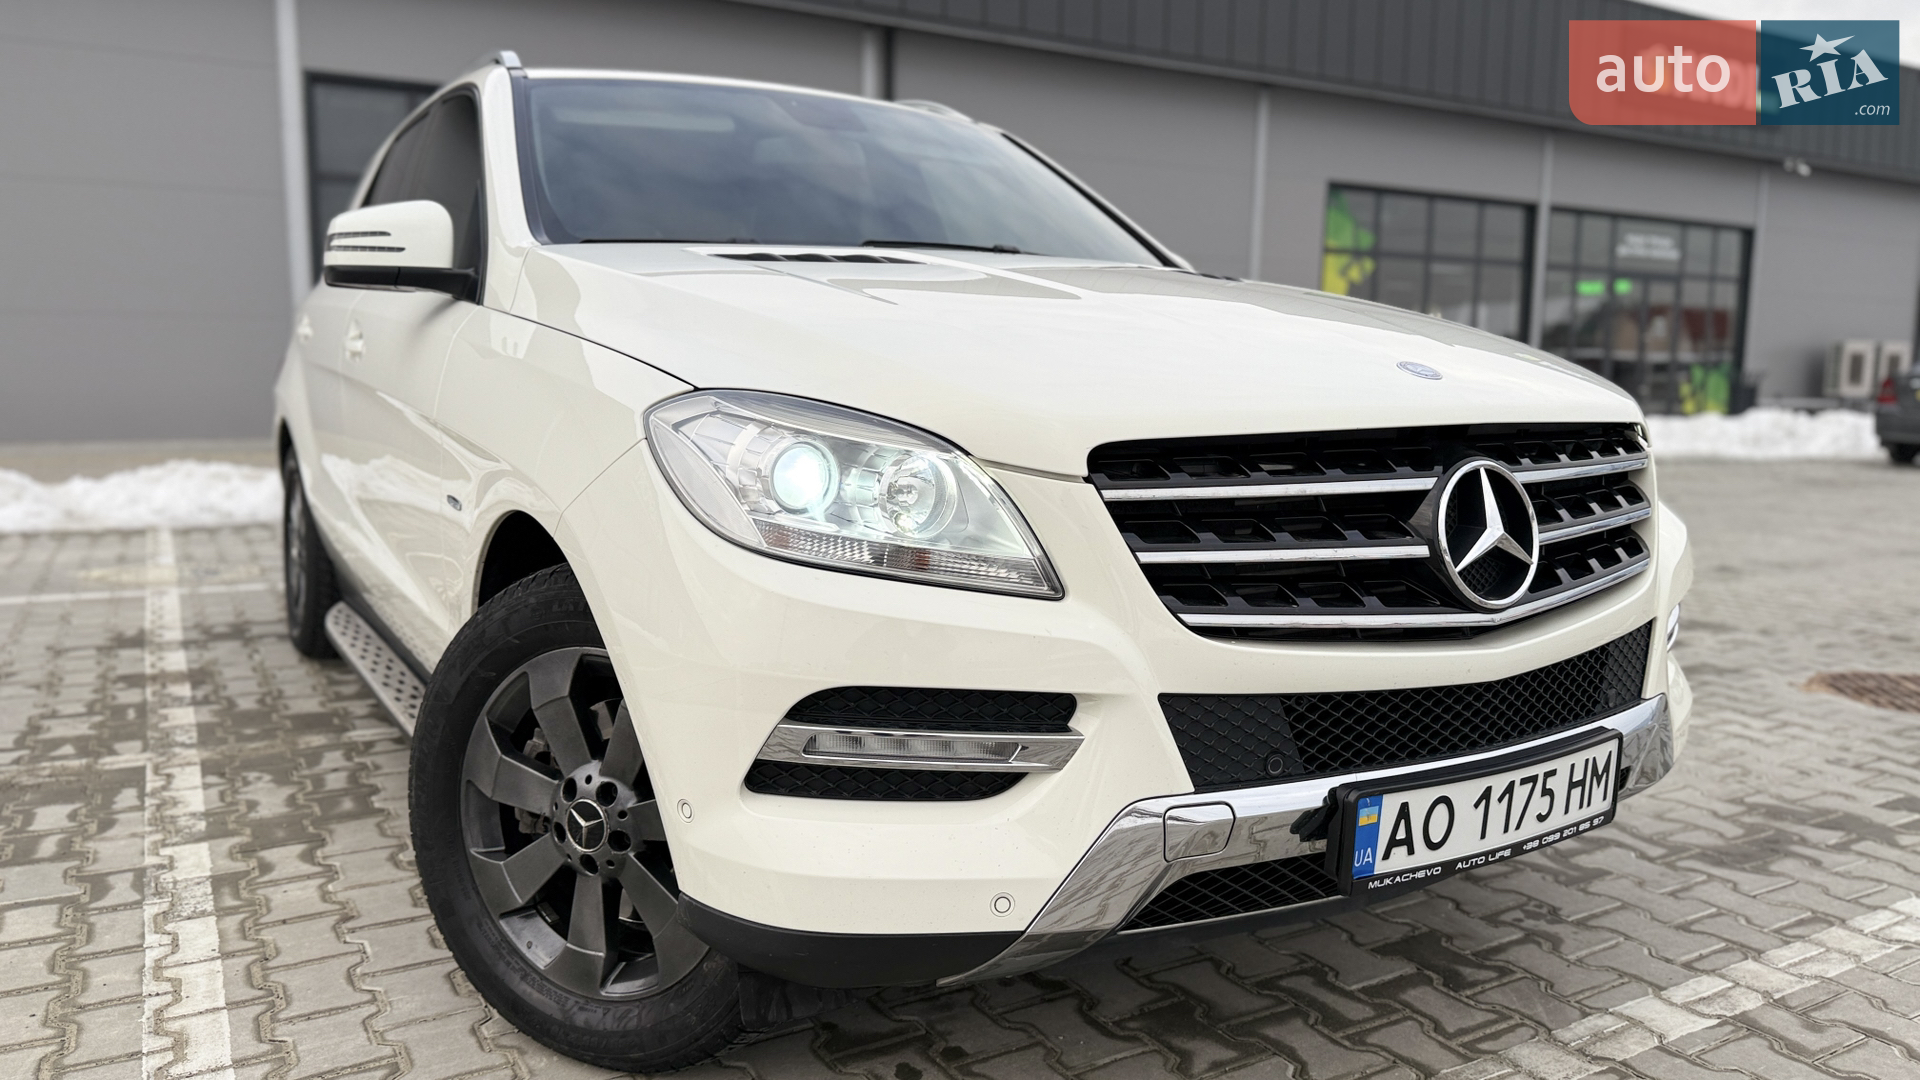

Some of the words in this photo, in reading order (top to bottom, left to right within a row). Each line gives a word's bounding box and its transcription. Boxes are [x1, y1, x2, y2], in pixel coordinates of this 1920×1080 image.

[1382, 795, 1455, 861] AO
[1473, 769, 1558, 840] 1175
[1564, 750, 1613, 815] HM
[1354, 847, 1373, 868] UA
[1368, 866, 1442, 890] MUKACHEVO
[1455, 856, 1486, 871] AUTO
[1488, 848, 1512, 862] LIFE
[1522, 839, 1540, 851] +38
[1541, 832, 1561, 845] 099
[1562, 826, 1577, 838] 201
